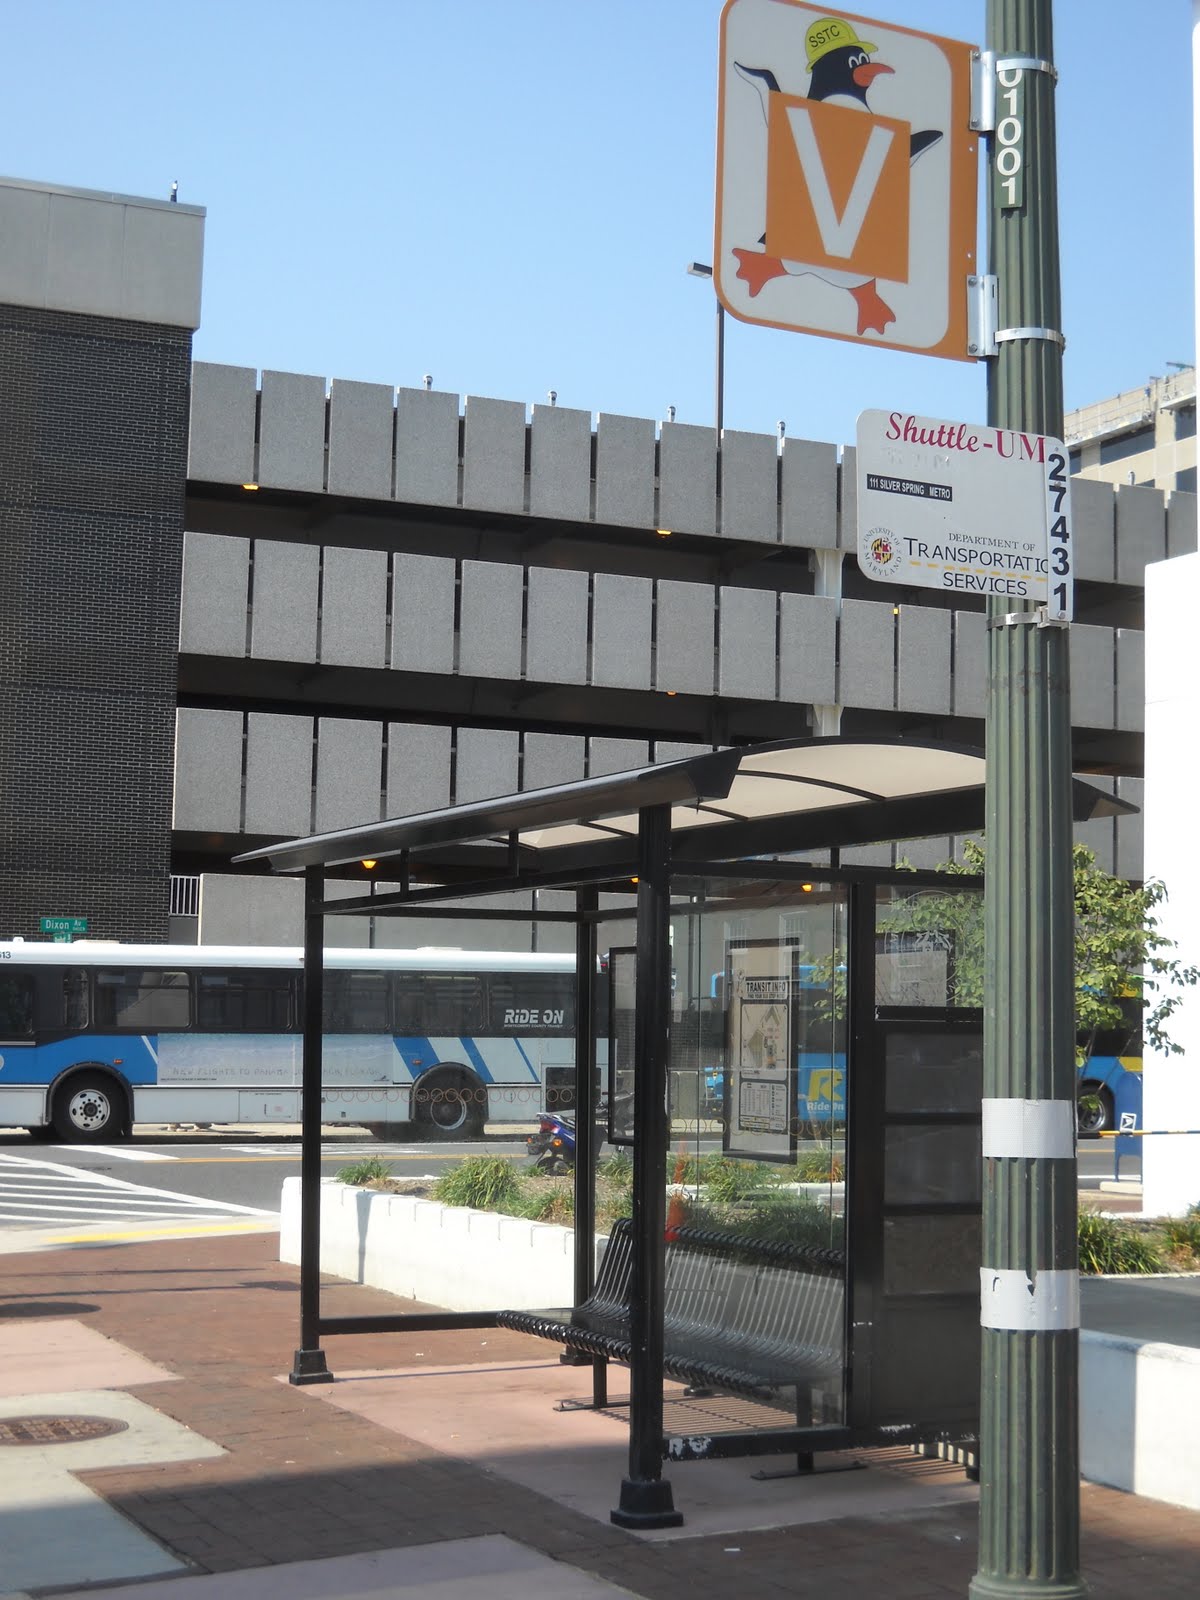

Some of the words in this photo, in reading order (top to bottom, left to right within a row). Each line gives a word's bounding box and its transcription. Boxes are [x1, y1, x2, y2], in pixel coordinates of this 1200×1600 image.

[808, 25, 840, 49] SSTC
[785, 106, 895, 260] V
[886, 411, 1045, 463] Shuttle-UM
[869, 477, 879, 488] 111
[880, 479, 901, 492] SILVER
[902, 482, 925, 495] SPRING
[929, 486, 951, 499] METRO
[863, 527, 895, 542] UNIVERSITY
[948, 532, 1019, 550] DEPARTMENT
[1022, 542, 1036, 552] OF
[1048, 453, 1070, 611] 27431
[864, 552, 902, 577] MARYLAND
[903, 537, 1049, 574] TRANSPORTATIO
[943, 571, 1027, 596] SERVICES
[45, 919, 70, 930] Dixon
[0, 951, 12, 960] 13
[746, 981, 771, 992] TRANSIT
[542, 1009, 565, 1025] ON
[807, 1102, 830, 1111] Ride
